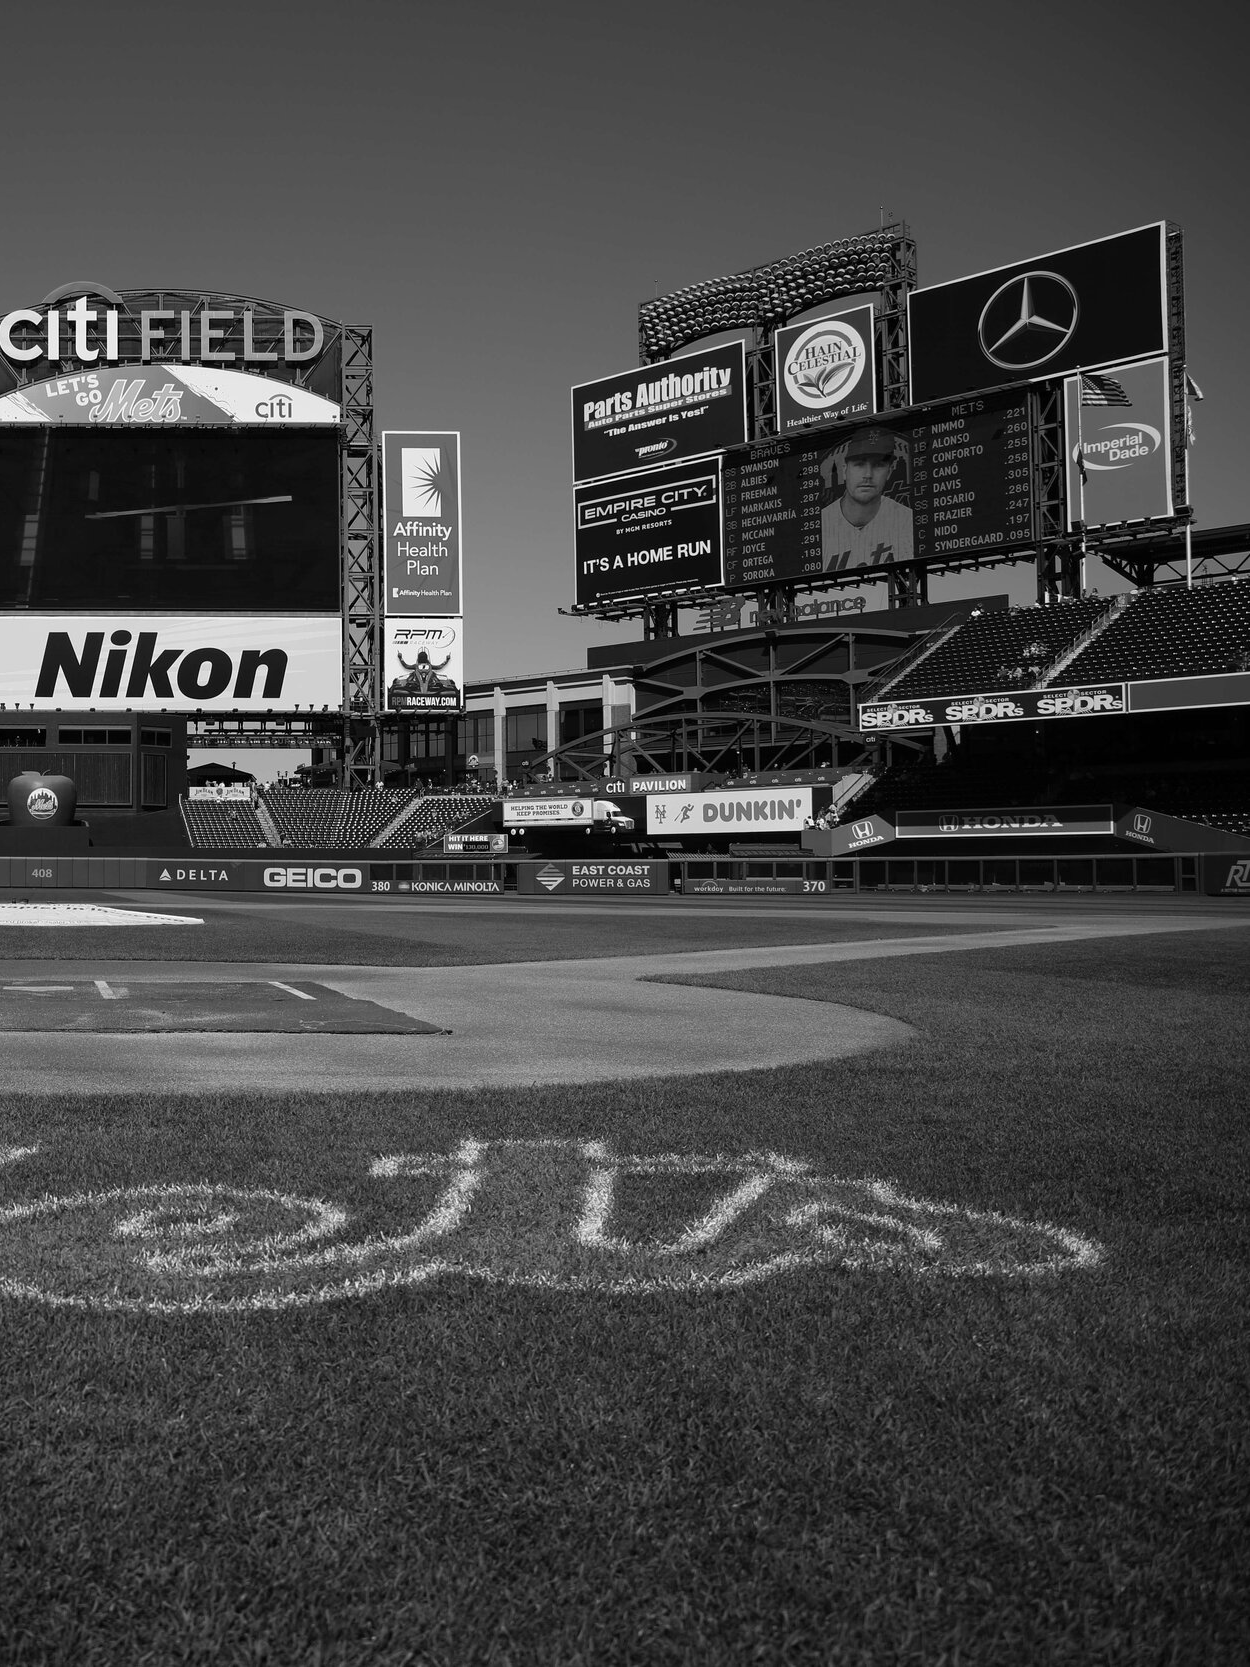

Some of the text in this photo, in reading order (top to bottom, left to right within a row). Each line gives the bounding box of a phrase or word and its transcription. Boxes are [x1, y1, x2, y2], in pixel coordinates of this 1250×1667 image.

[0, 296, 325, 361] citi FIELD
[805, 342, 842, 359] HAIN
[46, 375, 102, 407] LET'S GO
[583, 366, 732, 422] Parts Authority
[89, 379, 185, 422] Mets
[255, 396, 292, 418] citi
[588, 389, 727, 429] Auto Parts Super Stores
[951, 400, 984, 417] METS
[628, 417, 668, 432] Answer
[669, 413, 679, 422] Is
[786, 414, 822, 428] Healthier
[823, 410, 839, 420] Way
[840, 407, 849, 415] of
[931, 407, 1026, 434] NIMMO .221
[932, 421, 1028, 449] ALONSO .260
[1083, 432, 1143, 455] Imperial
[750, 443, 791, 460] BRAVES
[932, 437, 1028, 464] CONFORTO .255
[1109, 444, 1149, 462] Dade
[740, 459, 780, 475] SWANSON
[933, 452, 1028, 478] CANÓ .258
[741, 474, 768, 488] ALBIES
[933, 467, 1029, 493] DAVIS .305
[741, 486, 778, 501] FREEMAN
[933, 483, 1029, 508] ROSARIO .286
[584, 495, 657, 520] EMPIRE
[621, 507, 666, 522] CASINO
[741, 499, 783, 514] MARKAKIS
[934, 498, 1029, 523] FRAZIER .247
[625, 525, 641, 534] MGM
[642, 519, 673, 530] RESORTS
[741, 508, 797, 528] HECHAVARRÍA
[934, 513, 1030, 537] NIDO .197
[393, 521, 452, 540] Affinity
[742, 527, 775, 541] MCCANN
[742, 542, 766, 555] JOYCE
[934, 528, 1031, 552] SYNDERGAARD .095
[397, 541, 448, 557] Health
[583, 540, 711, 575] IT'S A HOME RUN
[406, 560, 439, 576] Plan
[742, 555, 774, 568] ORTEGA
[743, 568, 776, 581] SOROKA
[789, 596, 867, 619] balance
[394, 629, 444, 641] RPM
[35, 629, 288, 700] Nikon
[605, 780, 687, 793] citi PAVILION
[702, 799, 801, 824] DUNKIN'
[961, 814, 1064, 830] HONDA
[848, 834, 884, 848] HONDA
[1125, 830, 1155, 845] HONDA
[448, 843, 463, 851] WIN
[31, 868, 53, 879] 408
[177, 869, 229, 881] DELTA
[263, 867, 362, 888] GEICO
[572, 865, 650, 875] EAST COAST
[371, 881, 391, 892] 380
[411, 881, 500, 892] KONICA MINOLTA
[572, 878, 650, 888] POWER & GAS
[803, 881, 826, 892] 370
